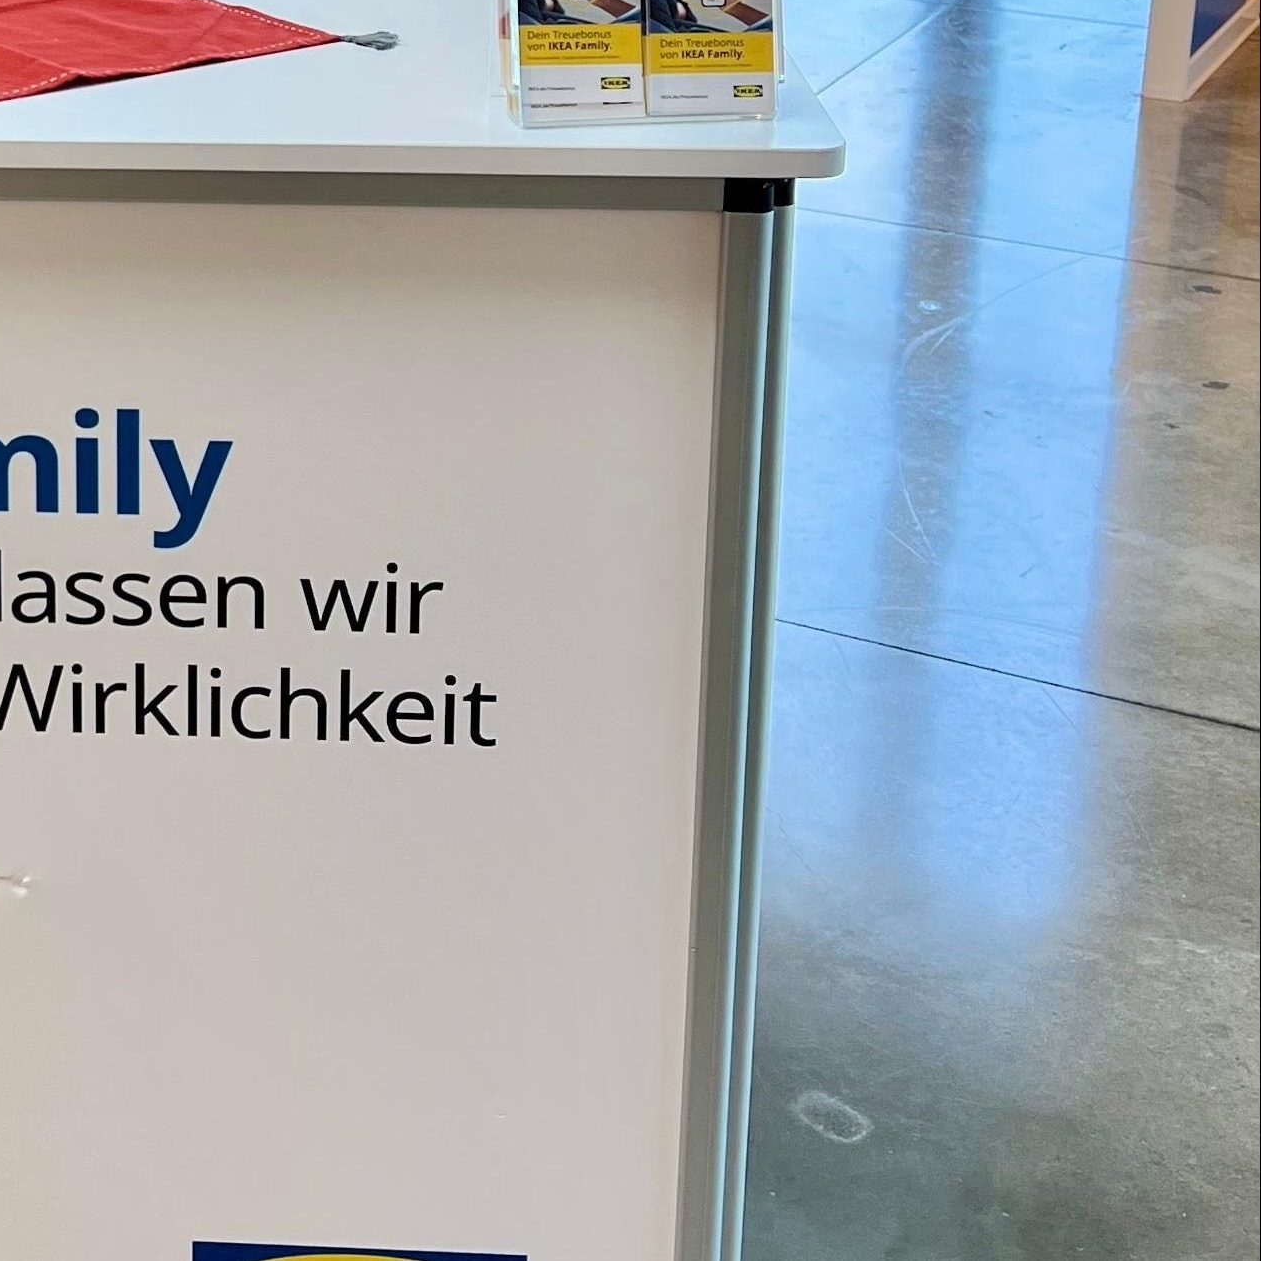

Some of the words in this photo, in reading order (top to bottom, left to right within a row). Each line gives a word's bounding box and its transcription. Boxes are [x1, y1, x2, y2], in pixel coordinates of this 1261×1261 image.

[527, 30, 550, 39] Dein
[553, 30, 612, 39] Treuebonus
[527, 43, 545, 51] von
[548, 41, 572, 50] IKEA
[575, 40, 613, 52] Family.
[660, 39, 683, 48] Dein
[685, 38, 744, 47] Treuebonus
[660, 51, 679, 59] von
[681, 49, 705, 59] IKEA
[708, 49, 745, 60] Family.
[299, 562, 444, 635] wir
